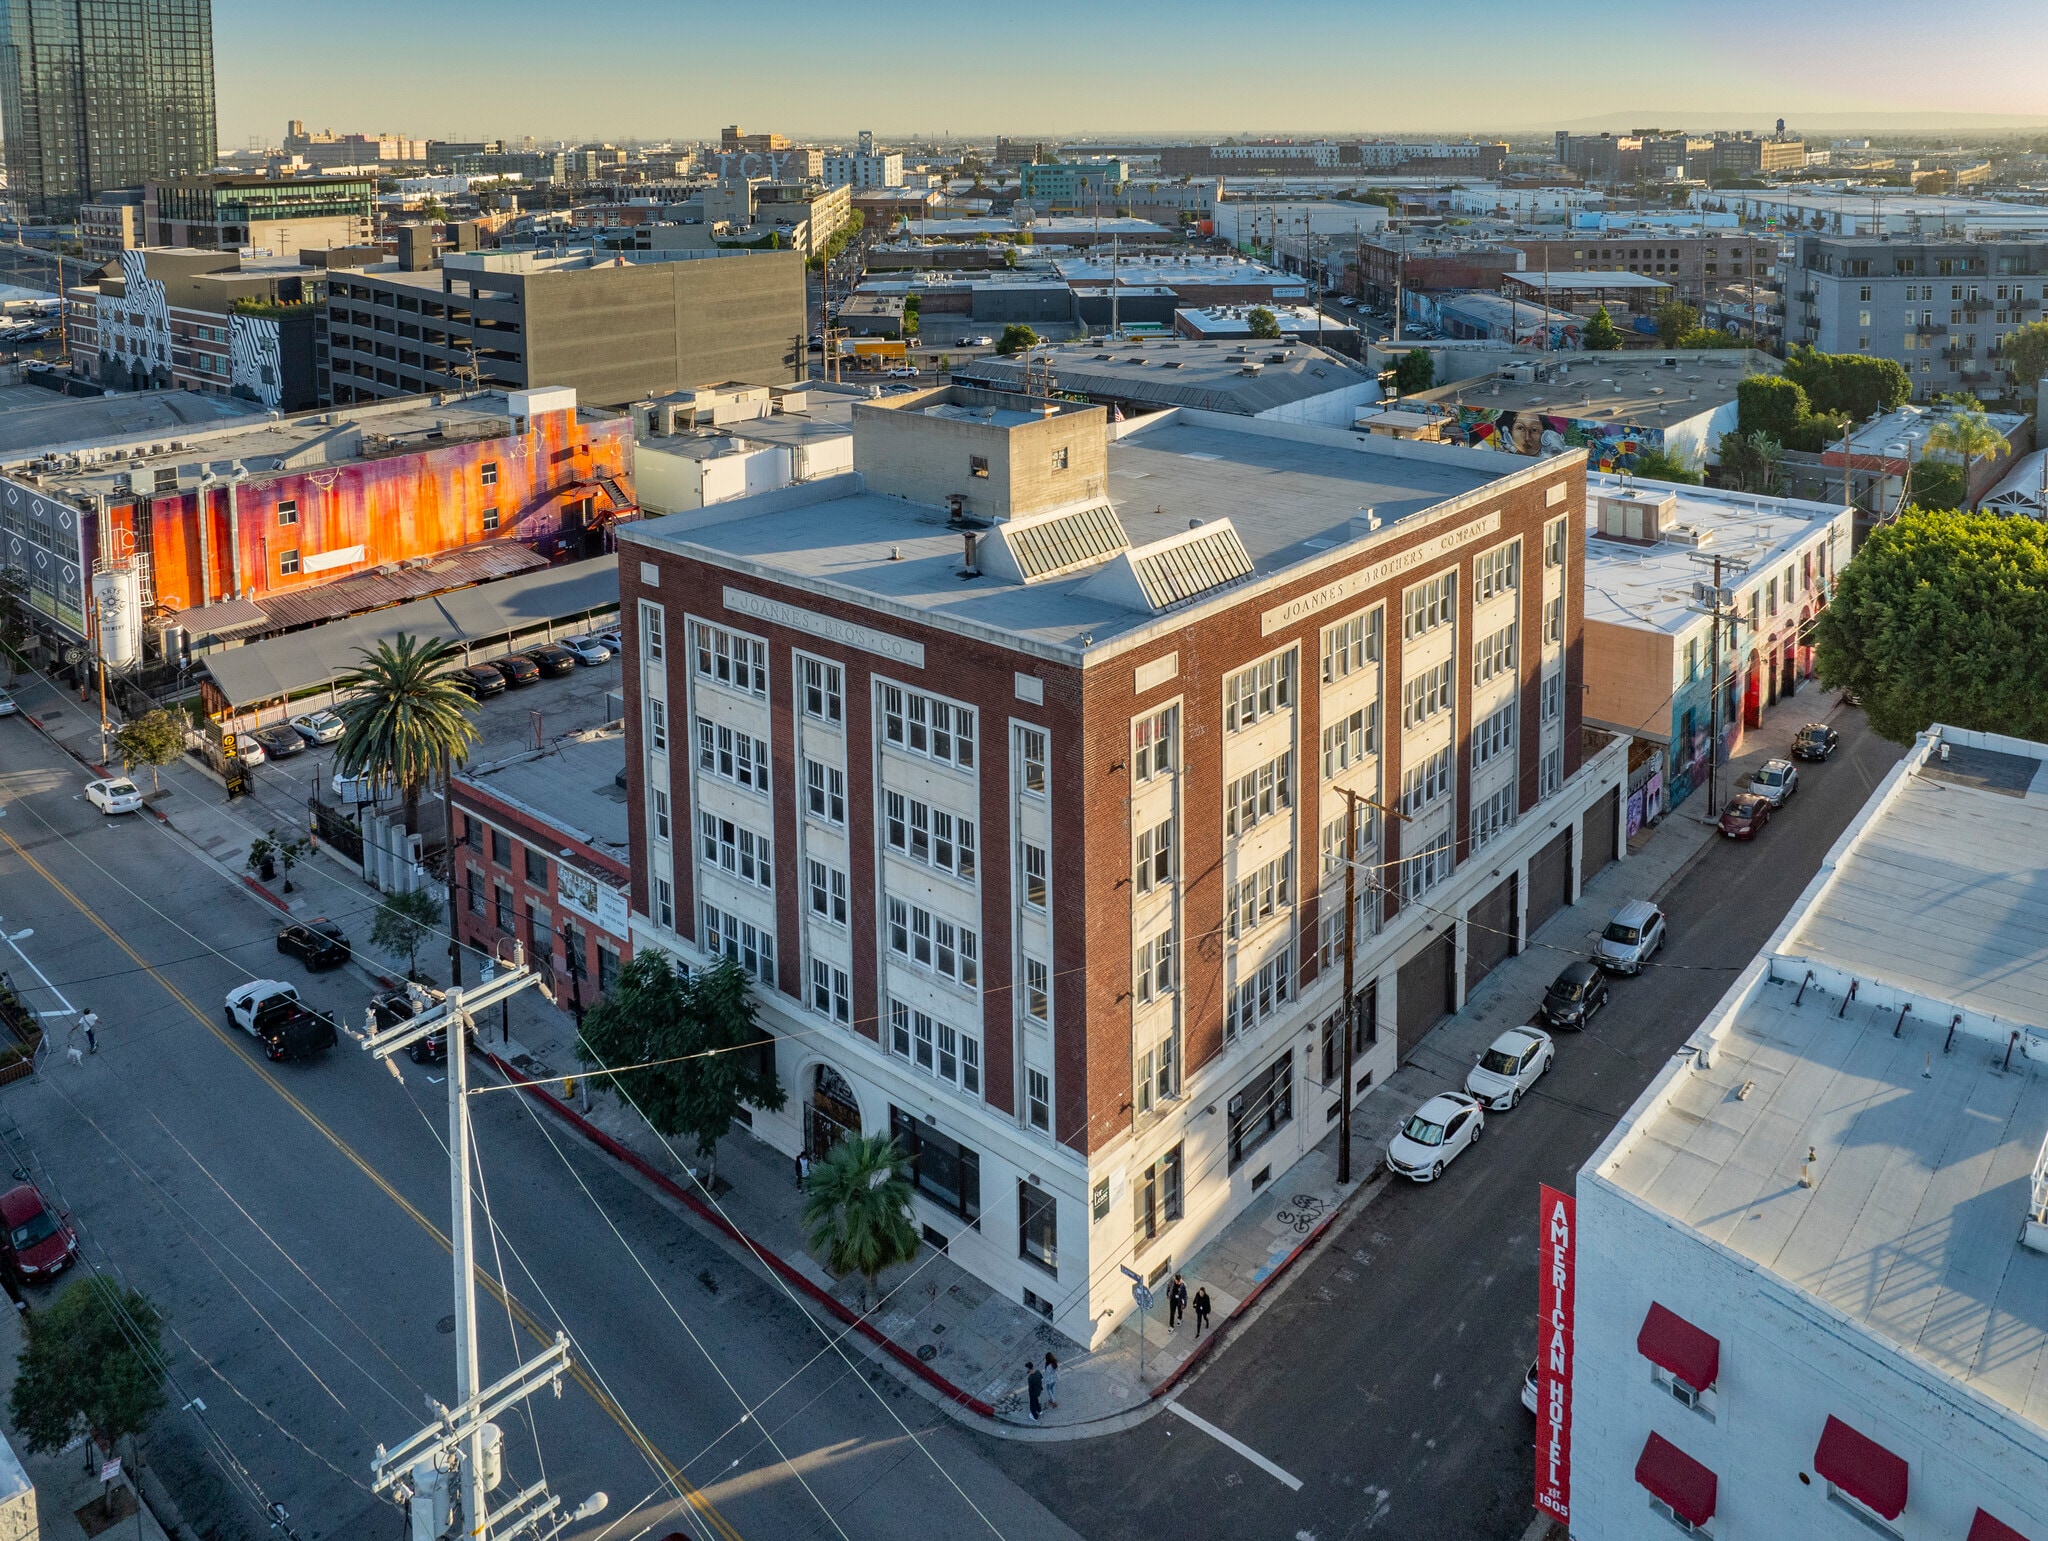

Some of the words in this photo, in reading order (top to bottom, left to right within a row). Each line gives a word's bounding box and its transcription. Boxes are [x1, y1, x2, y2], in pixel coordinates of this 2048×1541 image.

[714, 152, 791, 180] TOY
[1283, 583, 1344, 620] JOANNES
[1364, 548, 1424, 584] BROTHERS
[1440, 519, 1488, 549] COMPANY
[102, 588, 121, 597] ARTS
[102, 624, 125, 632] BREWERY
[740, 596, 810, 629] JOANNES
[880, 637, 904, 656] CO
[574, 874, 596, 894] LEASE
[1550, 1200, 1569, 1376] AMERICAN
[1549, 1379, 1564, 1487] HOTEL
[1539, 1492, 1569, 1517] 1905
